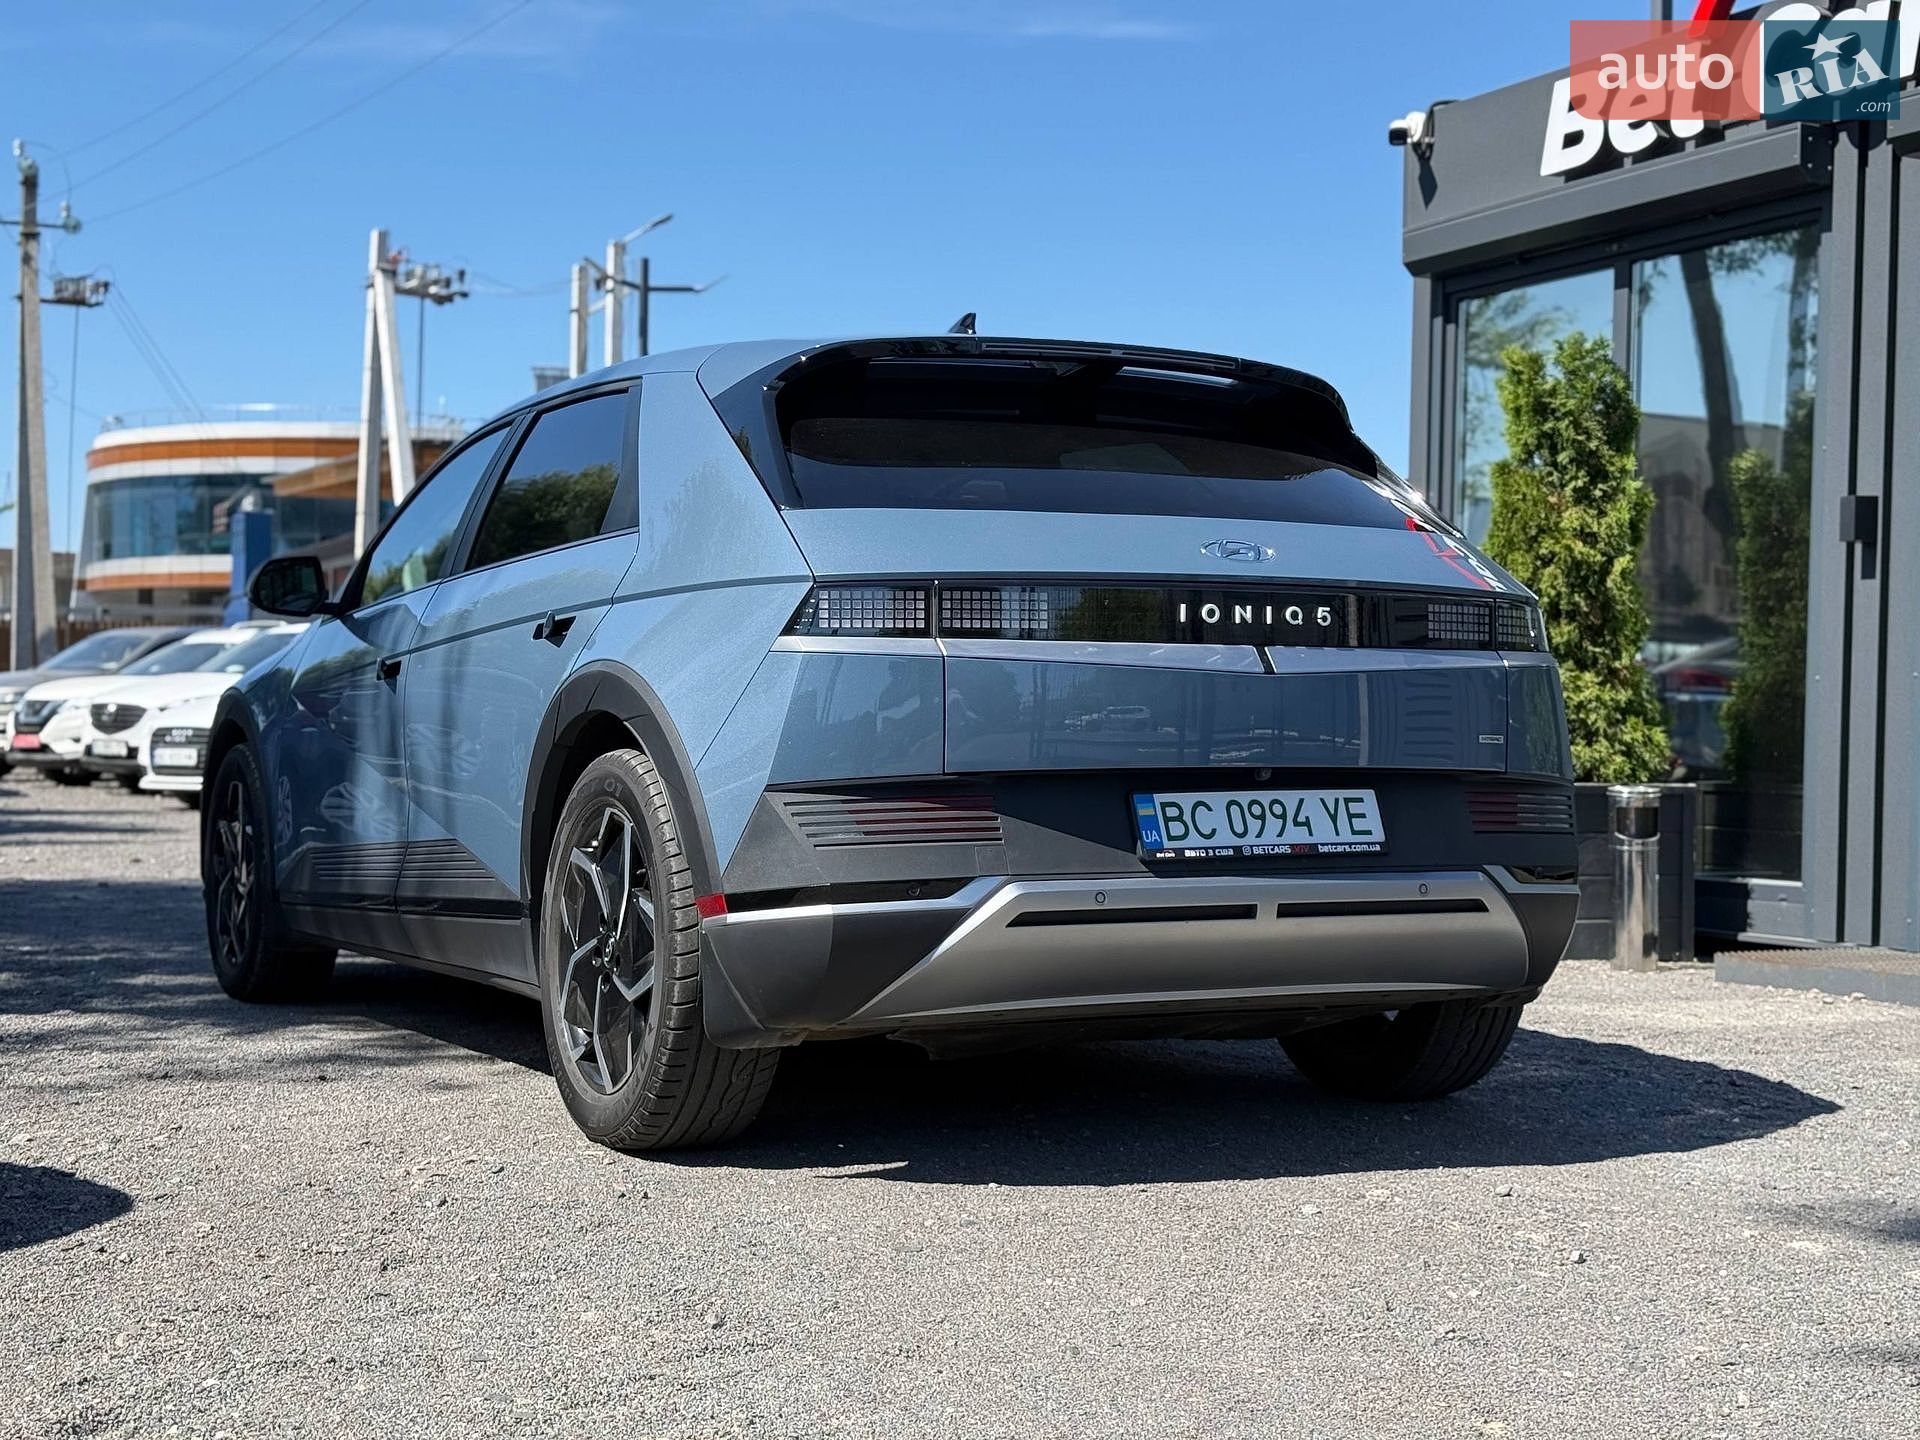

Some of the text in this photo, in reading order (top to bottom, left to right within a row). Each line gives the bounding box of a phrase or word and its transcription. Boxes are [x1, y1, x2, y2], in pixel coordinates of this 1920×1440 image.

[1179, 603, 1332, 627] IONIQ 5
[1159, 797, 1373, 842] BC 0994 YE
[1142, 830, 1161, 844] UA
[1318, 843, 1381, 853] betcars.com.ua
